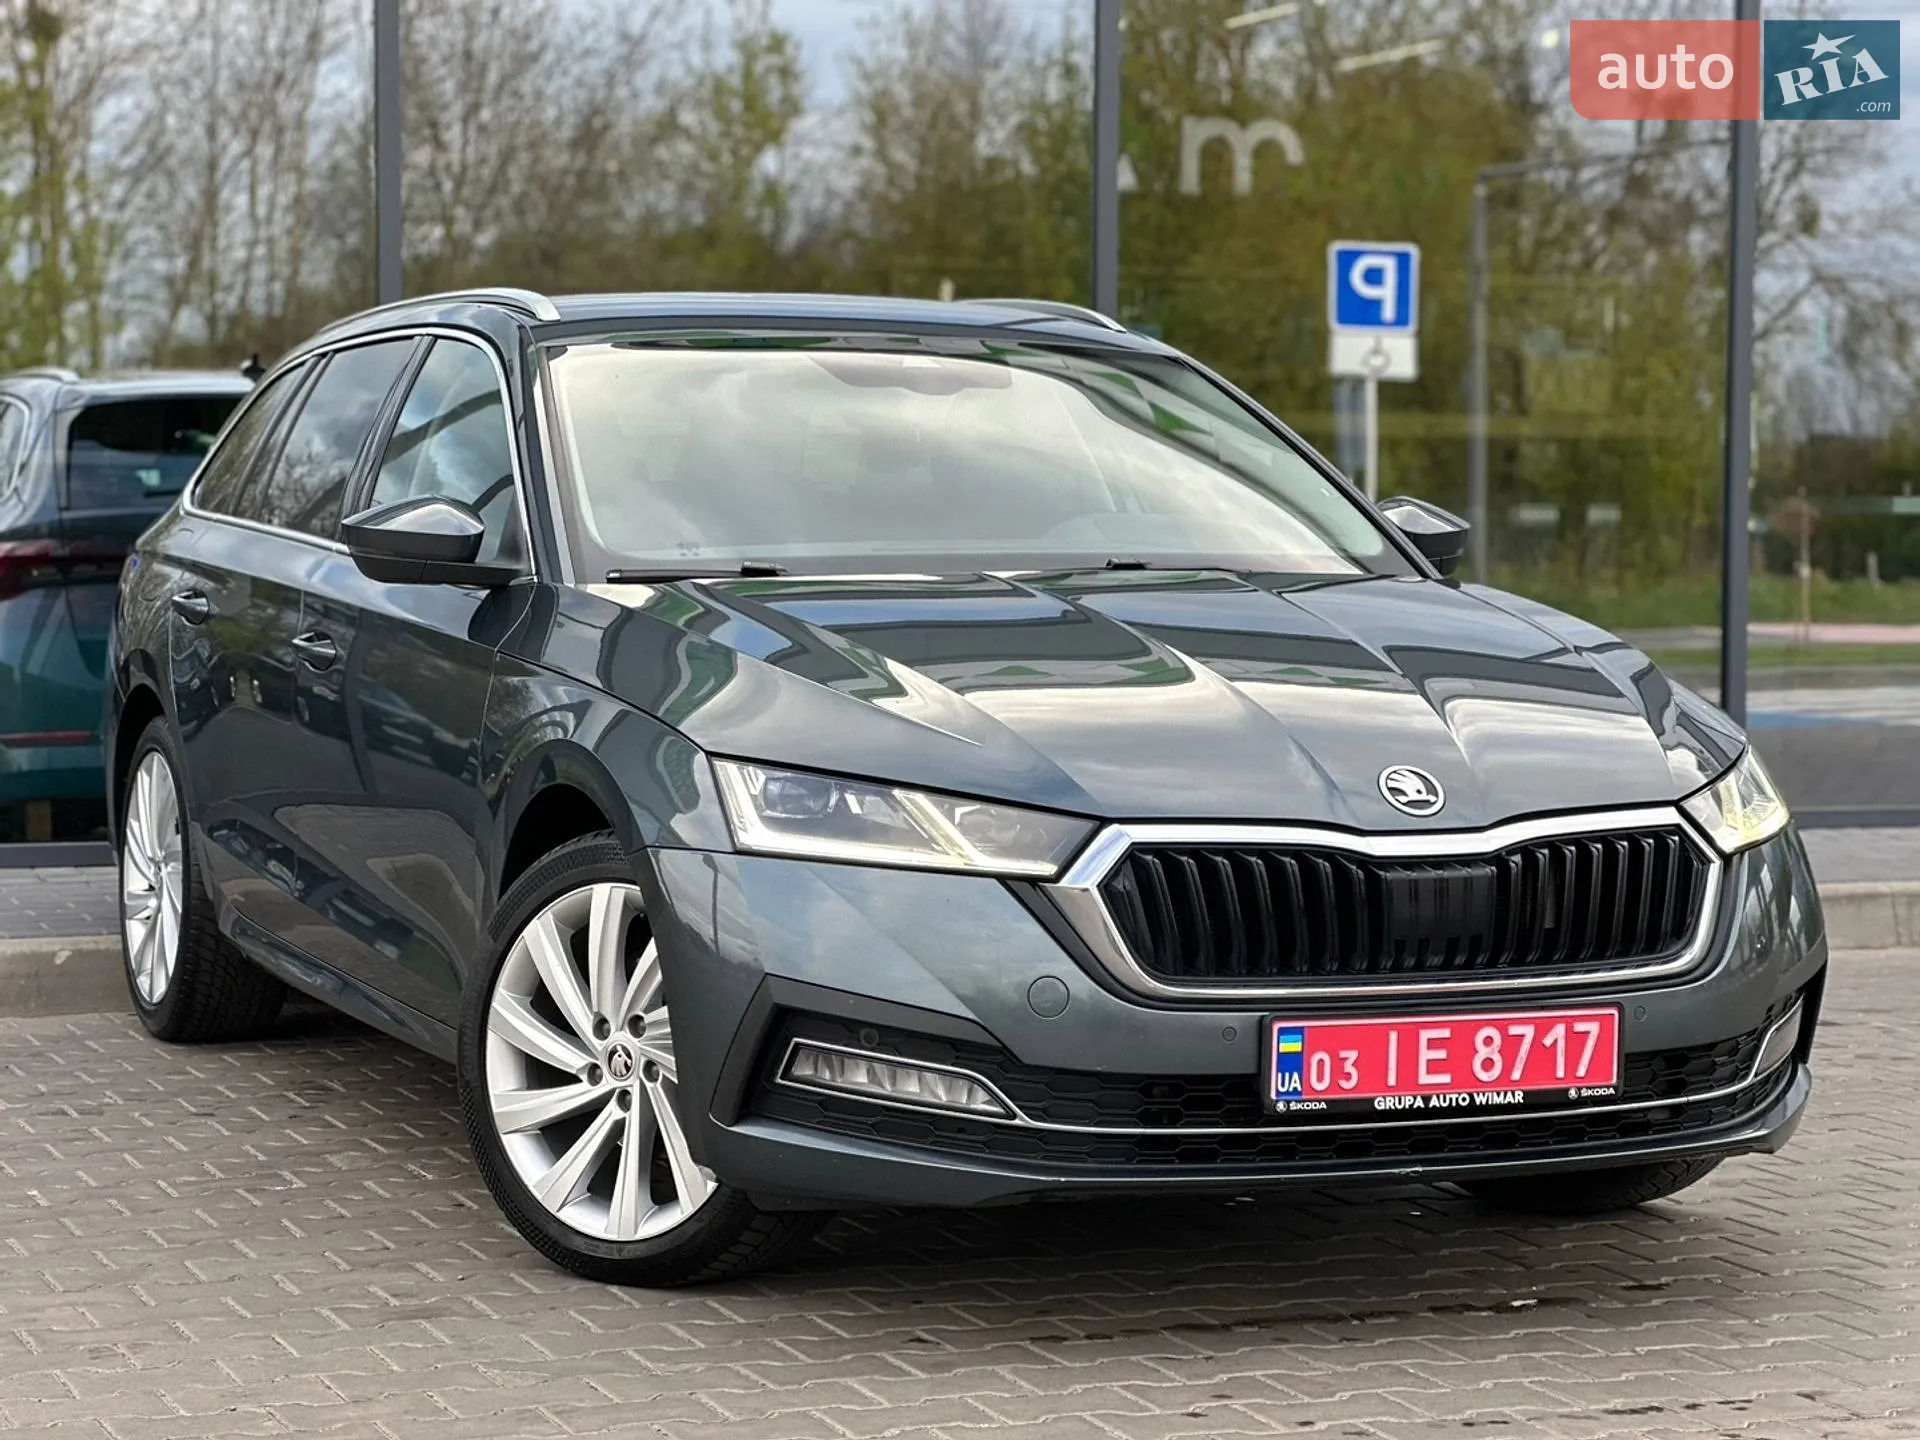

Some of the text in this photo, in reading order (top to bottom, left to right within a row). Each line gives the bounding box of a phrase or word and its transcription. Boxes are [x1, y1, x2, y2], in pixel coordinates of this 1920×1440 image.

[1309, 1050, 1359, 1091] 03
[1472, 1021, 1600, 1083] 8717
[1277, 1071, 1302, 1092] UA
[1374, 1090, 1525, 1110] GRUPA AUTO WIMAR
